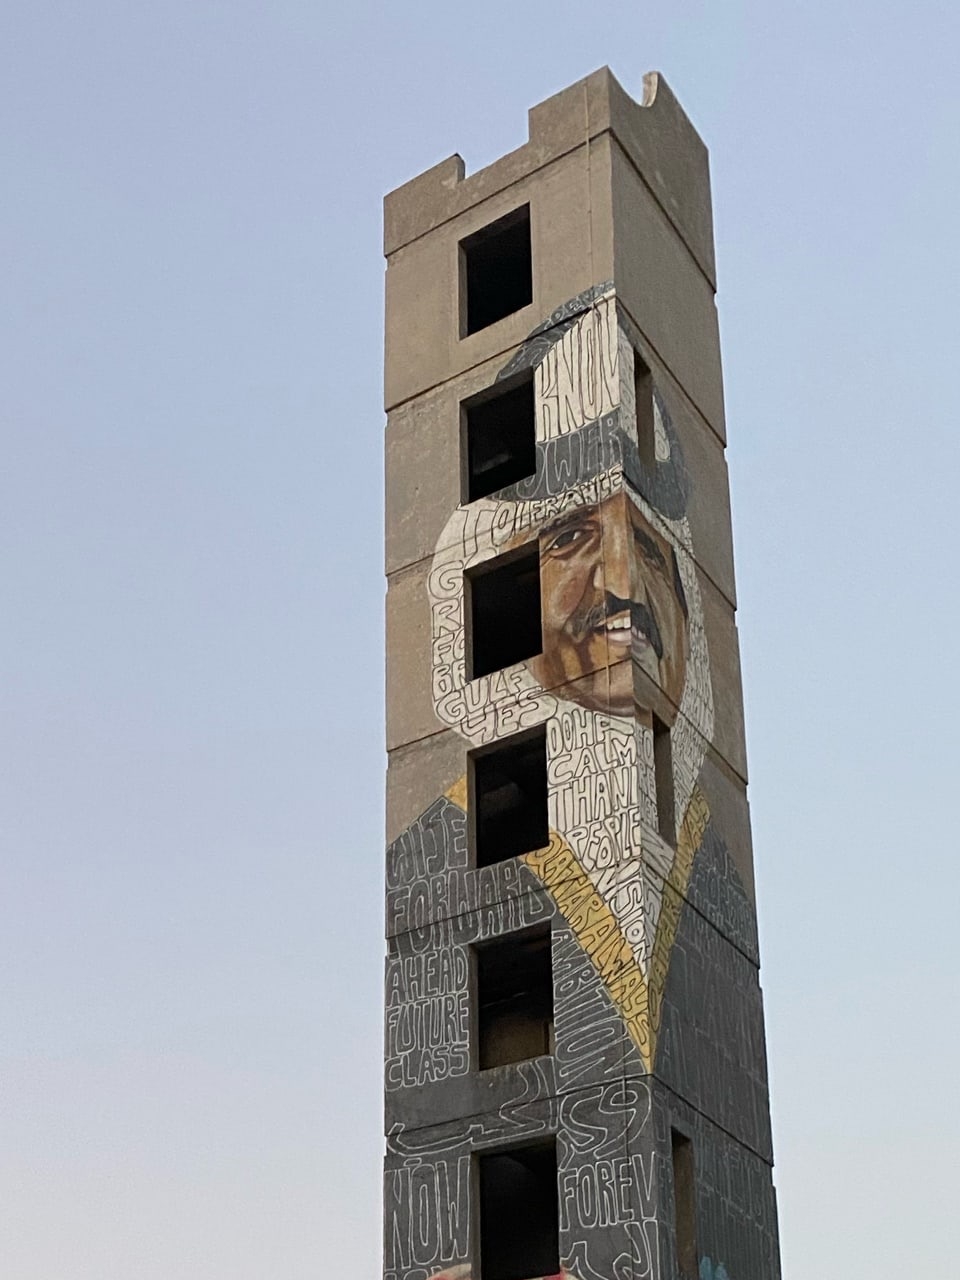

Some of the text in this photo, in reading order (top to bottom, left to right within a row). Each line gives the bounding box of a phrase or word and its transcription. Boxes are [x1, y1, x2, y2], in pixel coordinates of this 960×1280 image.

[457, 464, 623, 560] TOLERANCE
[436, 663, 528, 725] GULF
[460, 686, 559, 745] YES
[547, 709, 635, 758] DOHA
[548, 736, 637, 787] CALM
[548, 766, 639, 833] THANI
[386, 796, 468, 890] WISE
[565, 807, 642, 873] PEOPLE
[386, 858, 556, 962] FORWARD
[594, 859, 651, 972] VISION
[386, 944, 469, 1008] AHEAD
[524, 832, 607, 934] QATAR
[577, 914, 650, 1059] ALWAYS
[386, 991, 469, 1058] FUTURE
[552, 928, 648, 1094] AMBITION
[385, 1043, 470, 1091] CLASS
[385, 1155, 472, 1270] NOW
